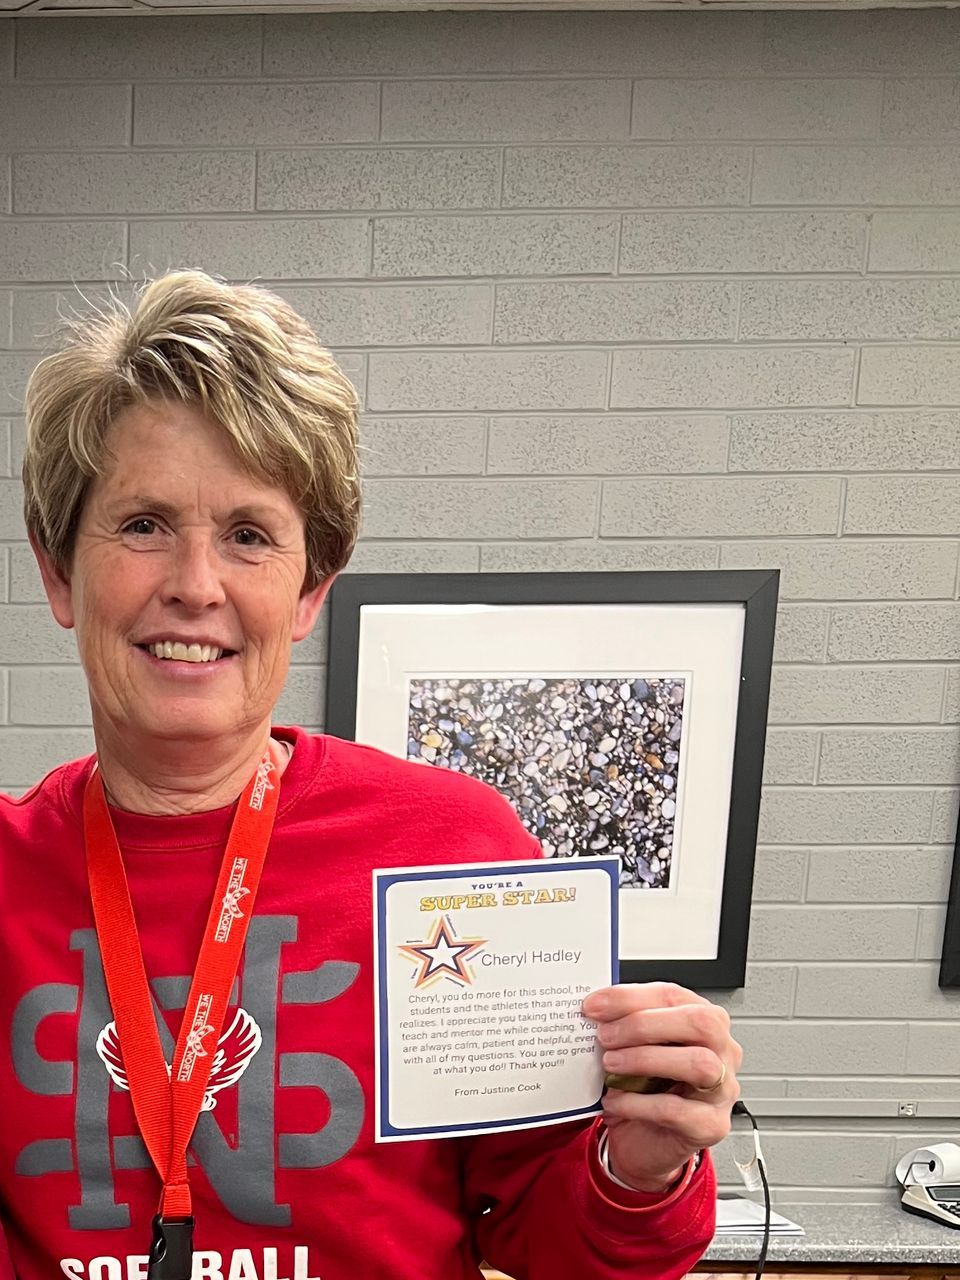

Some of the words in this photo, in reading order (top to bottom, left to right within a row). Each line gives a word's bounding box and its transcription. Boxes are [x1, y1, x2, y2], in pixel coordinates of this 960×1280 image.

[235, 858, 245, 872] WE
[230, 874, 241, 890] THE
[472, 882, 513, 890] YOU'RE
[420, 893, 498, 912] SUPER
[503, 887, 577, 906] STAR!
[217, 912, 231, 942] NORTH
[481, 952, 527, 968] Cheryl
[532, 950, 582, 965] Hadley
[201, 994, 210, 1008] WE
[409, 994, 440, 1004] Cheryl,
[442, 995, 459, 1003] you
[461, 992, 474, 1000] do
[476, 991, 500, 999] more
[504, 989, 517, 998] for
[519, 988, 537, 997] this
[539, 986, 573, 996] school,
[575, 985, 591, 993] the
[410, 1007, 451, 1016] students
[453, 1005, 471, 1013] and
[474, 1003, 489, 1012] the
[491, 1001, 529, 1011] athletes
[531, 1000, 553, 1008] than
[555, 999, 584, 1009] anyon
[195, 1011, 206, 1027] THE
[447, 1016, 497, 1026] appreciate
[498, 1015, 516, 1025] you
[518, 1012, 547, 1022] taking
[549, 1012, 565, 1020] the
[402, 1032, 428, 1041] teach
[430, 1030, 448, 1039] and
[450, 1029, 484, 1038] mentor
[486, 1028, 501, 1036] me
[504, 1025, 529, 1034] while
[580, 1022, 598, 1030] You
[403, 1045, 418, 1053] are
[420, 1043, 452, 1053] always
[454, 1041, 480, 1050] calm,
[482, 1039, 515, 1050] patient
[517, 1037, 535, 1046] and
[537, 1035, 573, 1046] helpful,
[574, 1034, 597, 1043] even
[403, 1056, 423, 1065] with
[425, 1055, 437, 1063] all
[439, 1054, 449, 1063] of
[451, 1055, 466, 1064] my
[467, 1051, 515, 1062] questions.
[519, 1049, 537, 1058] You
[539, 1049, 555, 1057] are
[571, 1045, 595, 1056] great
[180, 1050, 193, 1082] NORTH
[433, 1067, 442, 1075] at
[444, 1065, 467, 1074] what
[470, 1065, 487, 1074] you
[489, 1063, 507, 1072] do!!
[509, 1061, 537, 1070] Thank
[454, 1088, 479, 1097] From
[481, 1085, 515, 1095] Justine
[517, 1083, 541, 1092] Cook
